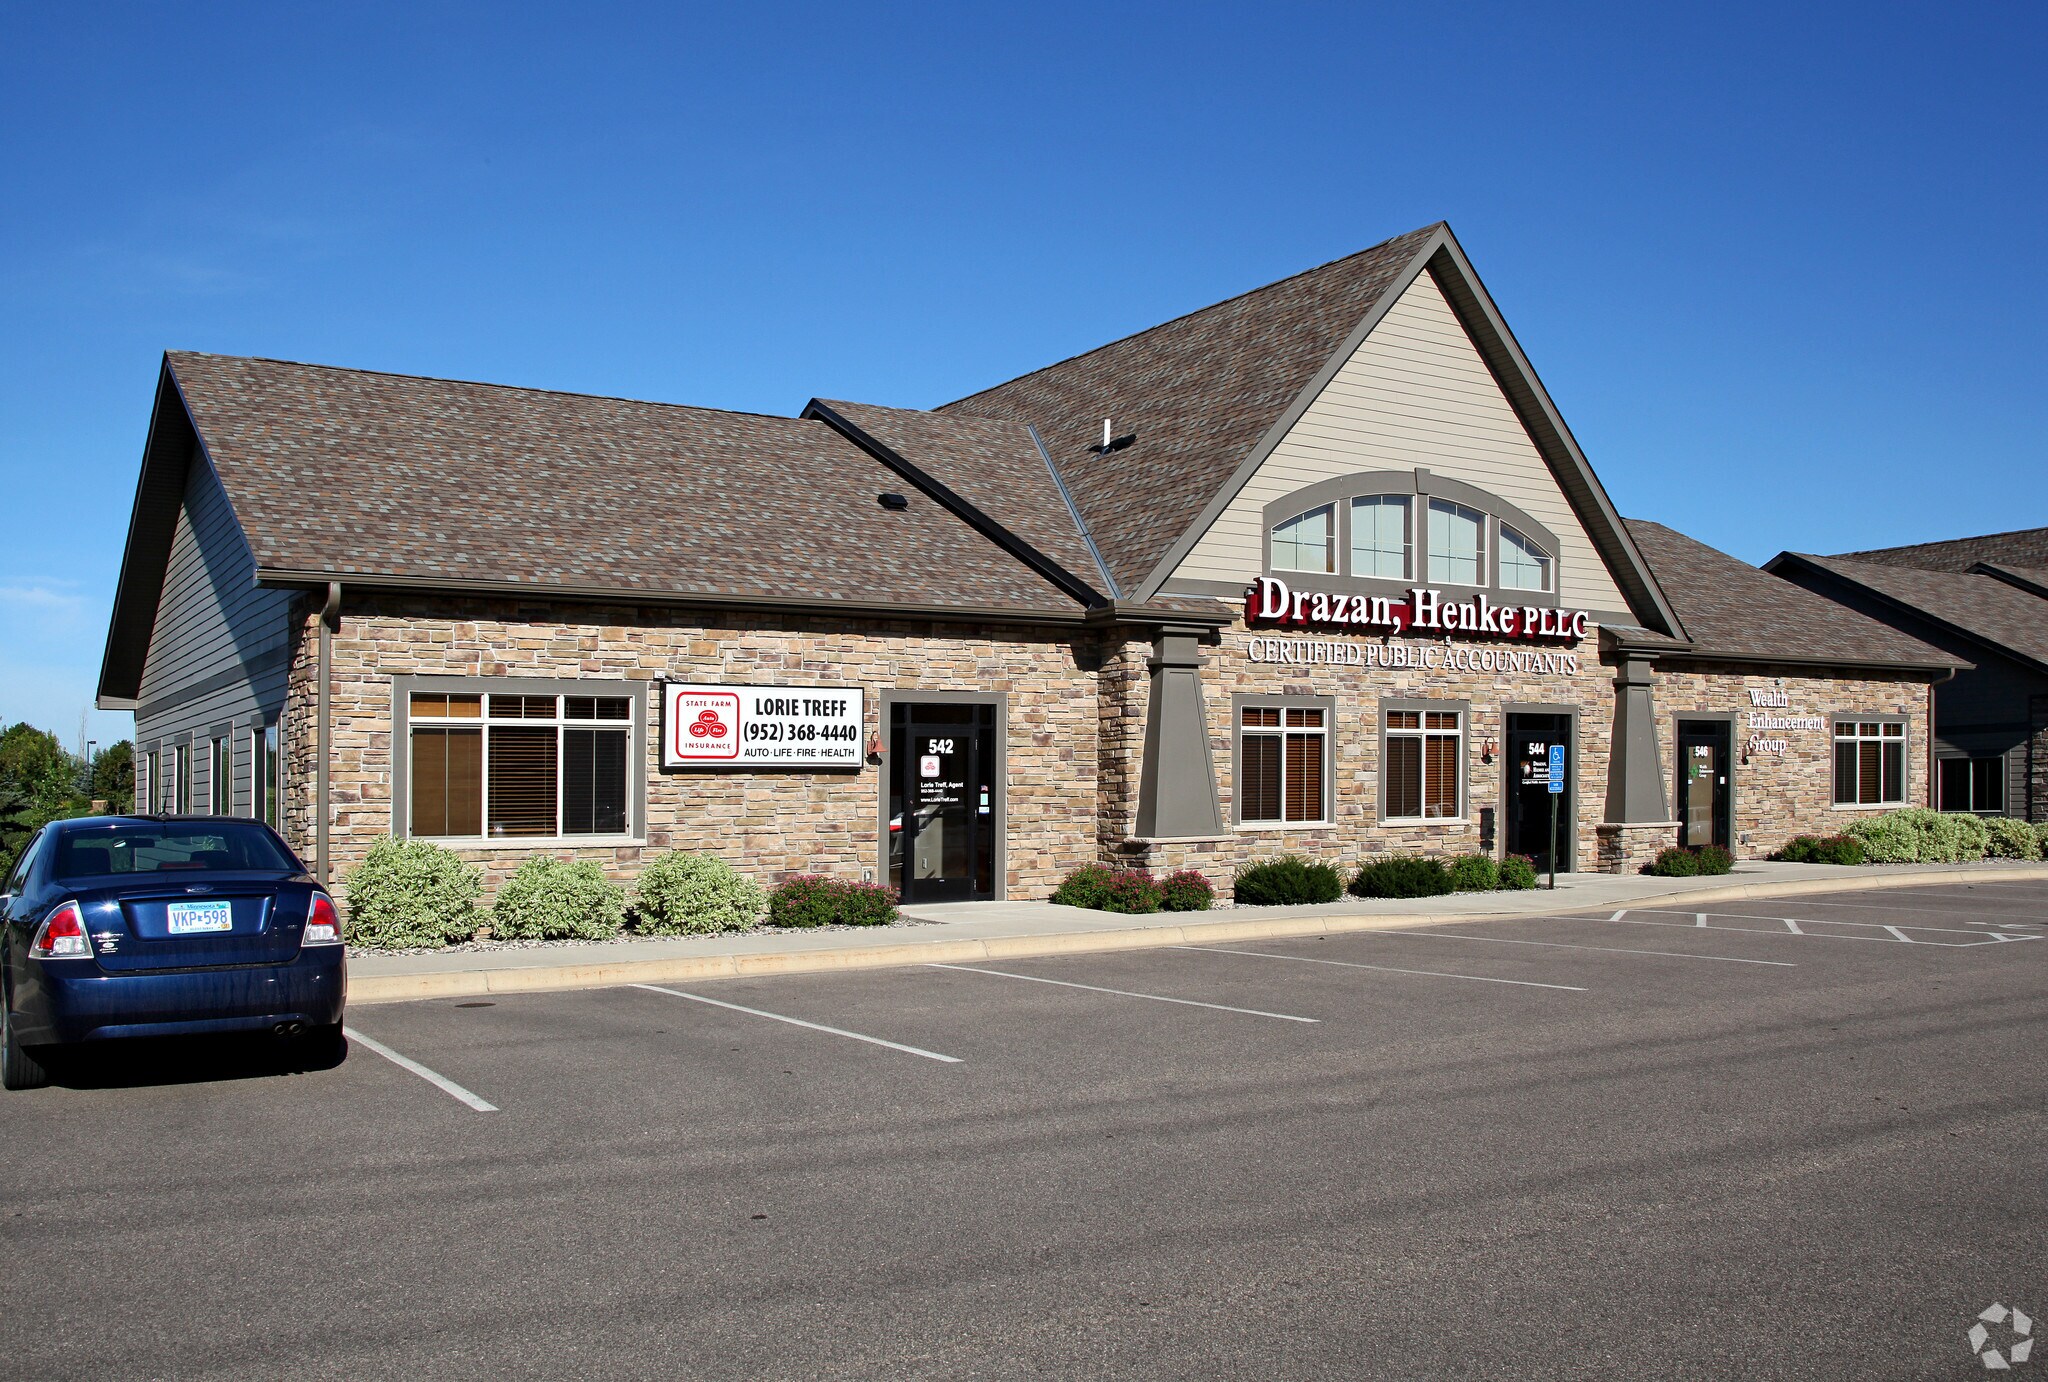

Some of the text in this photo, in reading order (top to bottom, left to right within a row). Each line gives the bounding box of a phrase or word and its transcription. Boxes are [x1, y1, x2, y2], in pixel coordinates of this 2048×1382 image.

[1258, 576, 1589, 638] Drazan, Henke PLLC
[1249, 637, 1577, 675] CERTIFIED PUBLIC ACCOUNTANTS
[755, 698, 847, 717] LORIE TREFF
[1749, 689, 1788, 707] Wealth
[1747, 711, 1825, 730] Enhancement
[743, 721, 857, 742] (952) 368-4440
[928, 739, 954, 754] 542
[1528, 742, 1545, 755] 544
[1695, 746, 1709, 757] 546
[1749, 734, 1787, 757] Group
